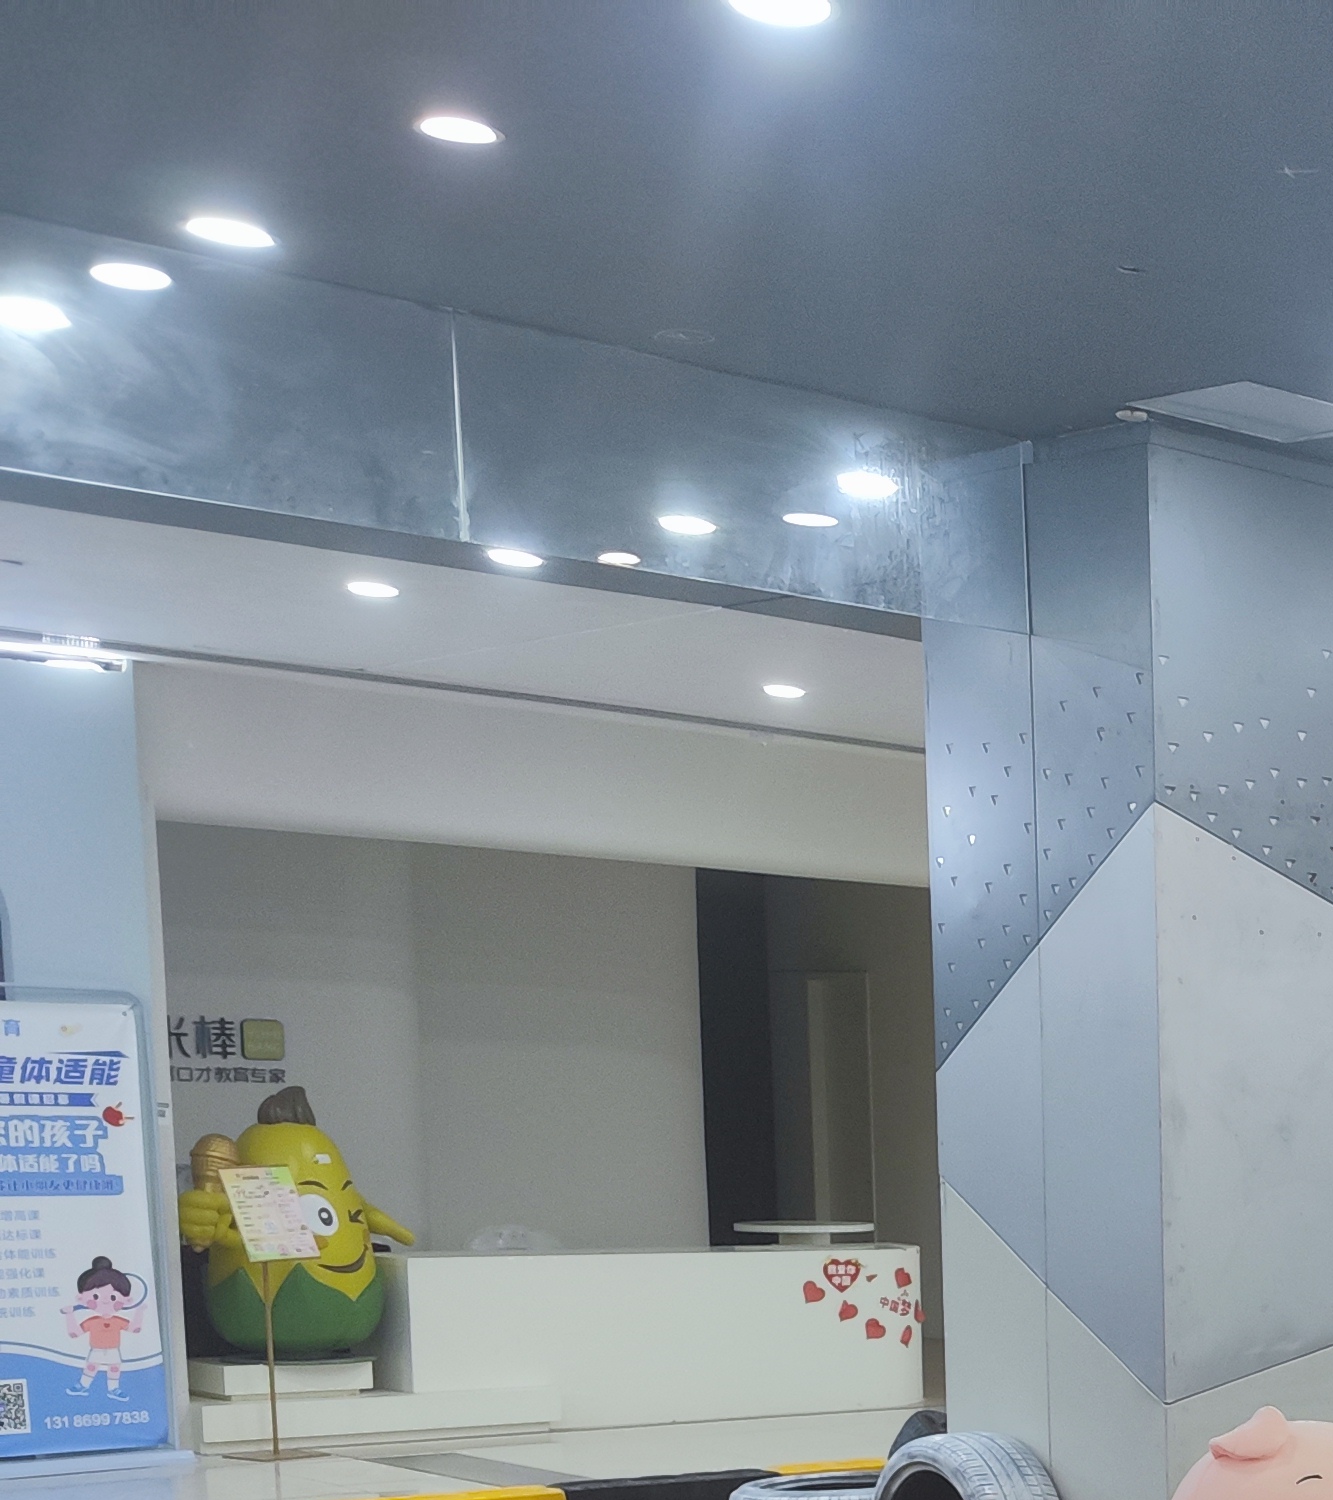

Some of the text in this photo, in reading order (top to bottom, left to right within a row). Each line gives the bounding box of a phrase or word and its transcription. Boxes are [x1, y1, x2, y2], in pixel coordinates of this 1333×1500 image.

[170, 1066, 286, 1083] 口才教育专家
[44, 1415, 69, 1430] 131
